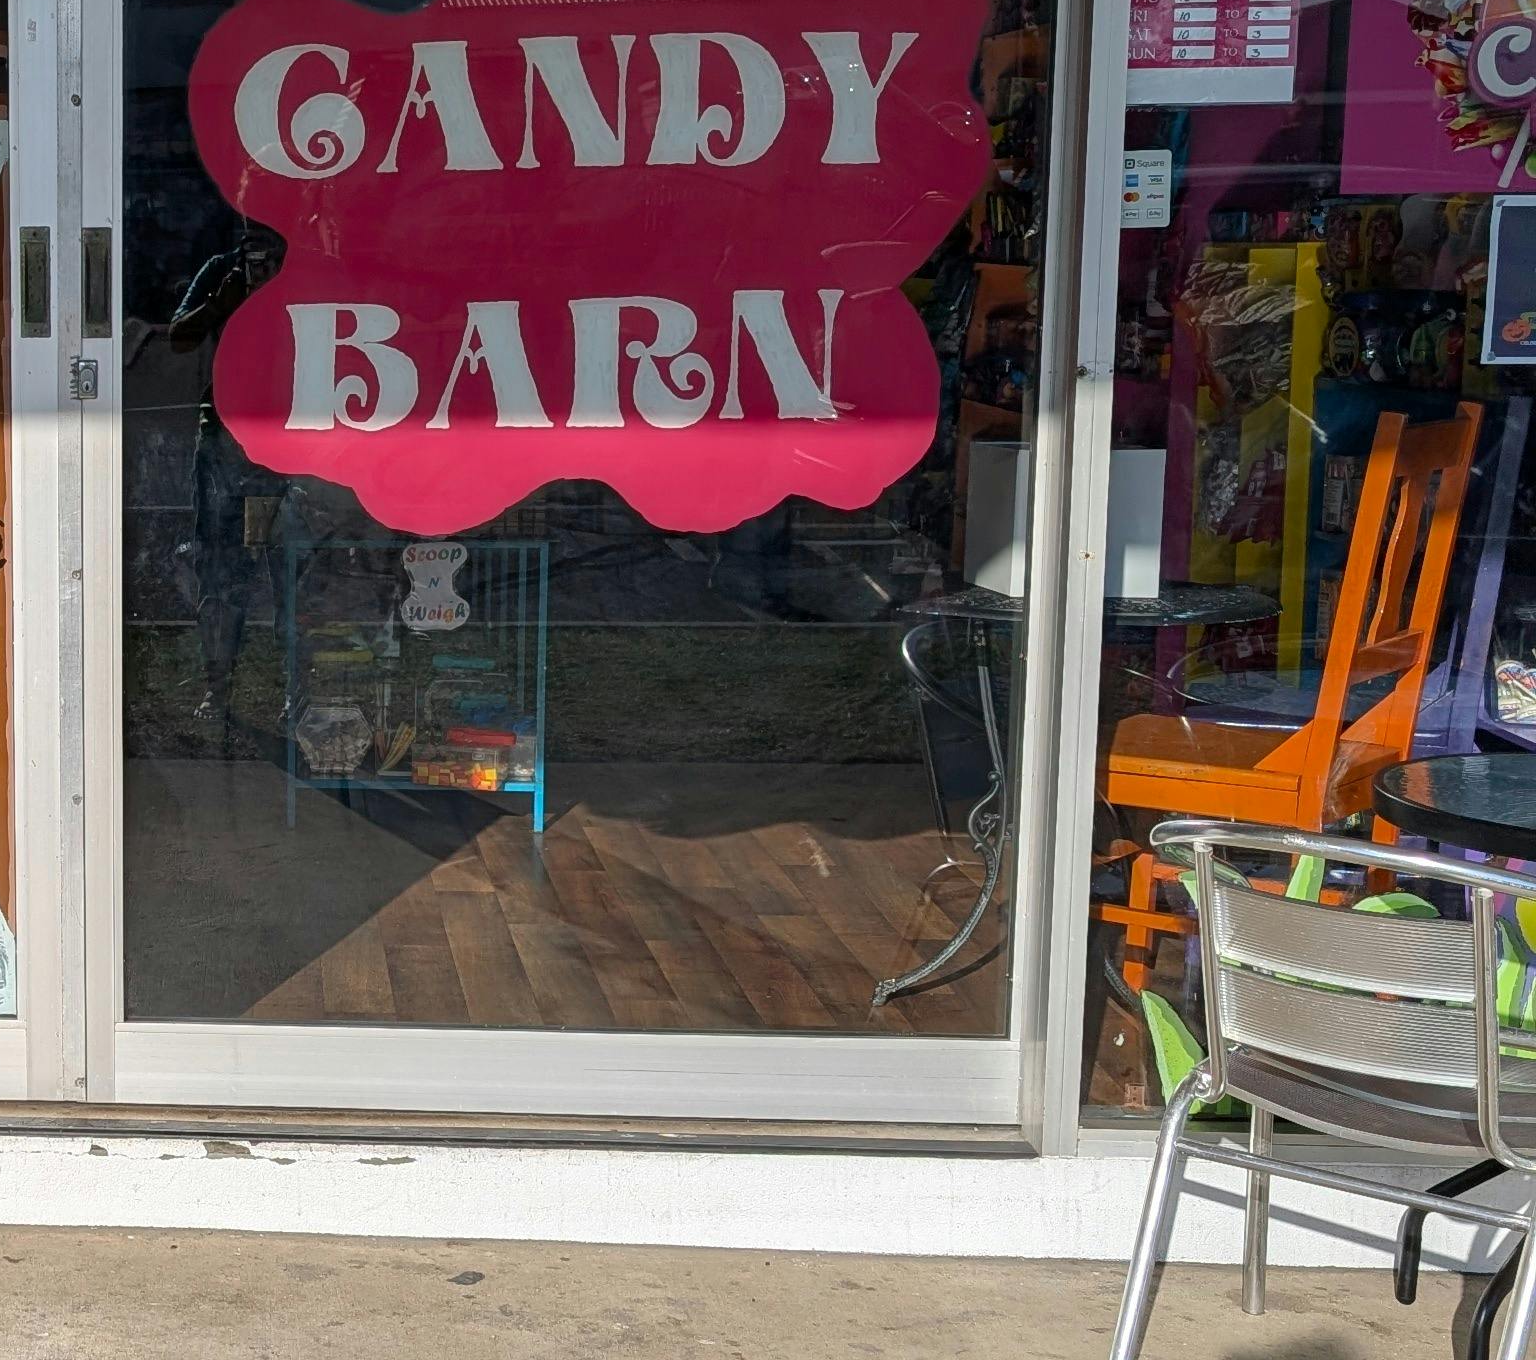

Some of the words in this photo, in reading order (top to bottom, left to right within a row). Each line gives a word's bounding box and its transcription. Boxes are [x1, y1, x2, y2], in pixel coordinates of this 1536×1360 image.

[1179, 12, 1190, 21] 10
[1225, 10, 1240, 18] TO
[1253, 11, 1262, 20] 5
[1177, 30, 1189, 39] 10
[1223, 29, 1239, 37] TO
[1252, 30, 1261, 39] 3
[1176, 49, 1186, 58] 10
[1223, 48, 1237, 56] TO
[1251, 49, 1260, 57] 3
[234, 30, 919, 180] CANDY
[1137, 160, 1164, 168] Square
[283, 288, 844, 432] BARN
[406, 547, 462, 563] Scoop
[429, 577, 439, 588] N
[405, 603, 466, 623] Weigh
